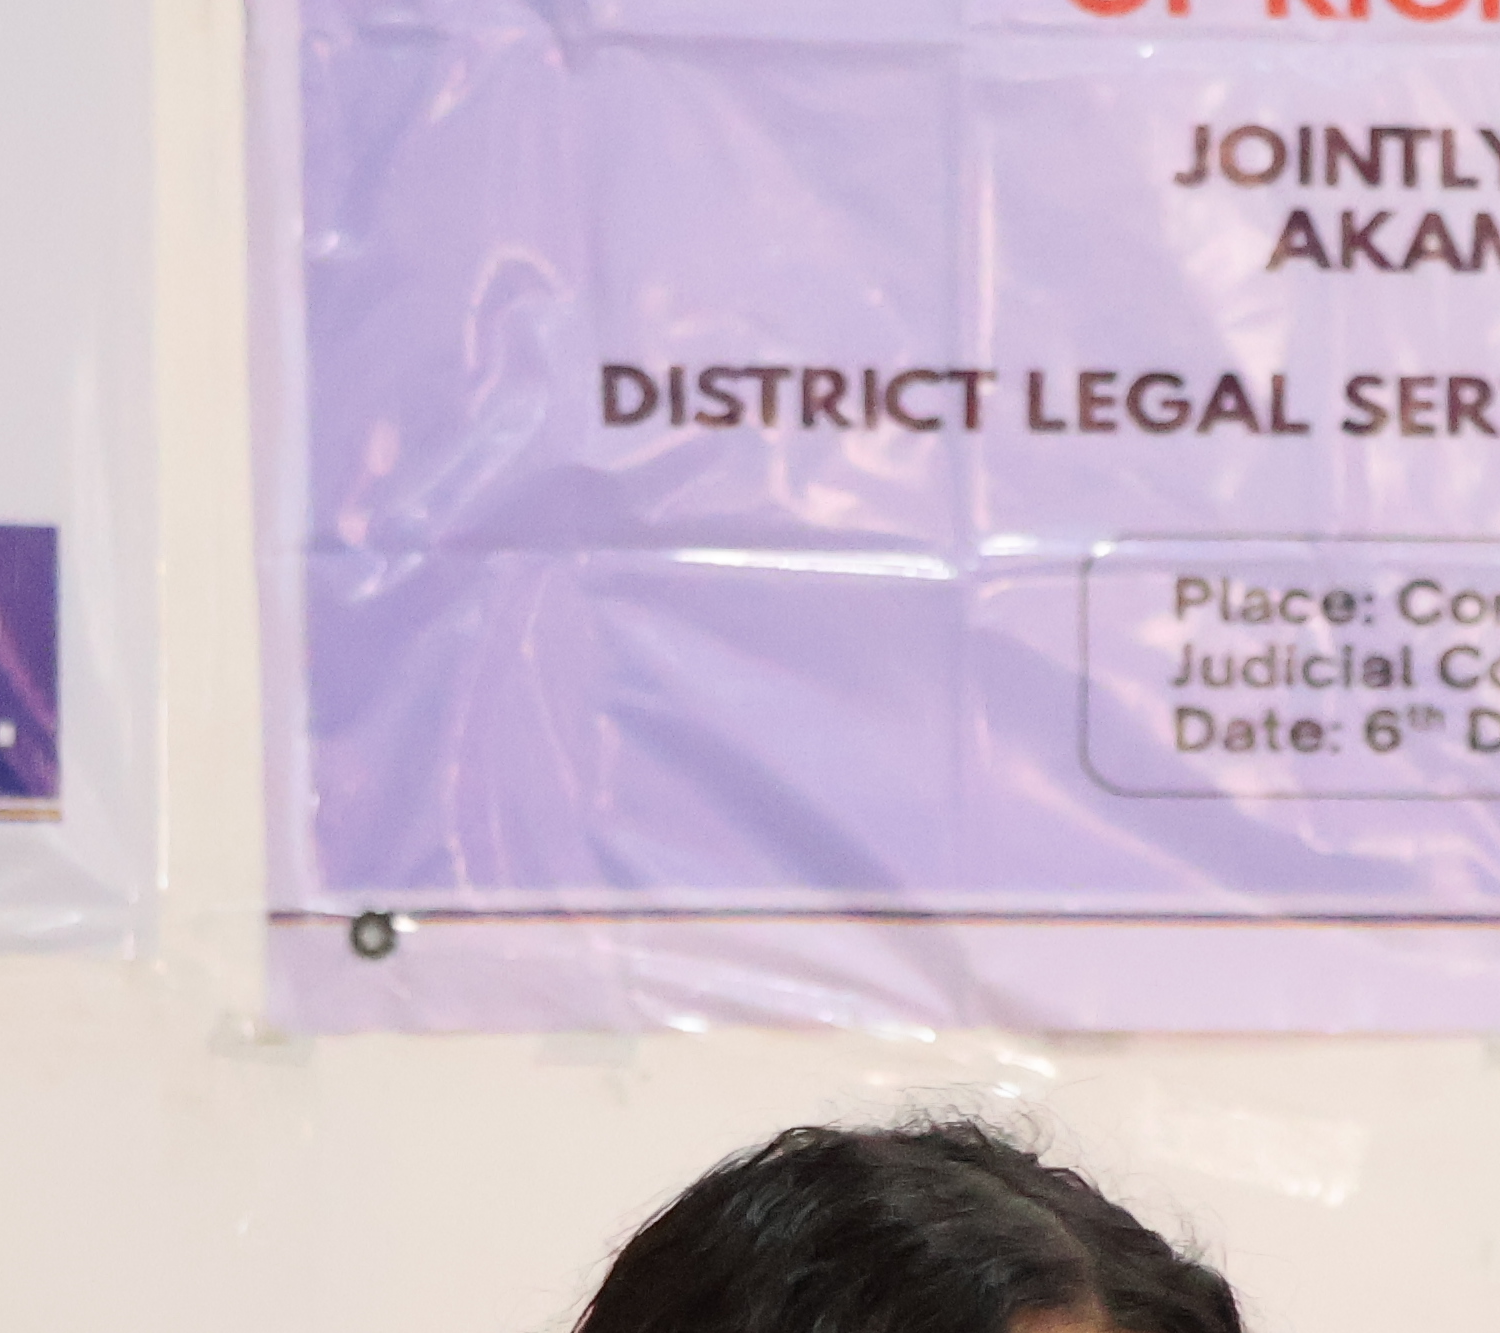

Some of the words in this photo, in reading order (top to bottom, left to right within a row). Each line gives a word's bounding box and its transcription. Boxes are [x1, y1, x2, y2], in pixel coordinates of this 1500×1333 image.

[601, 363, 996, 432] DISTRICT
[1027, 370, 1310, 435] LEGAL
[1176, 575, 1374, 626] Place:
[1172, 643, 1415, 690] Judicial
[1174, 705, 1341, 754] Date:
